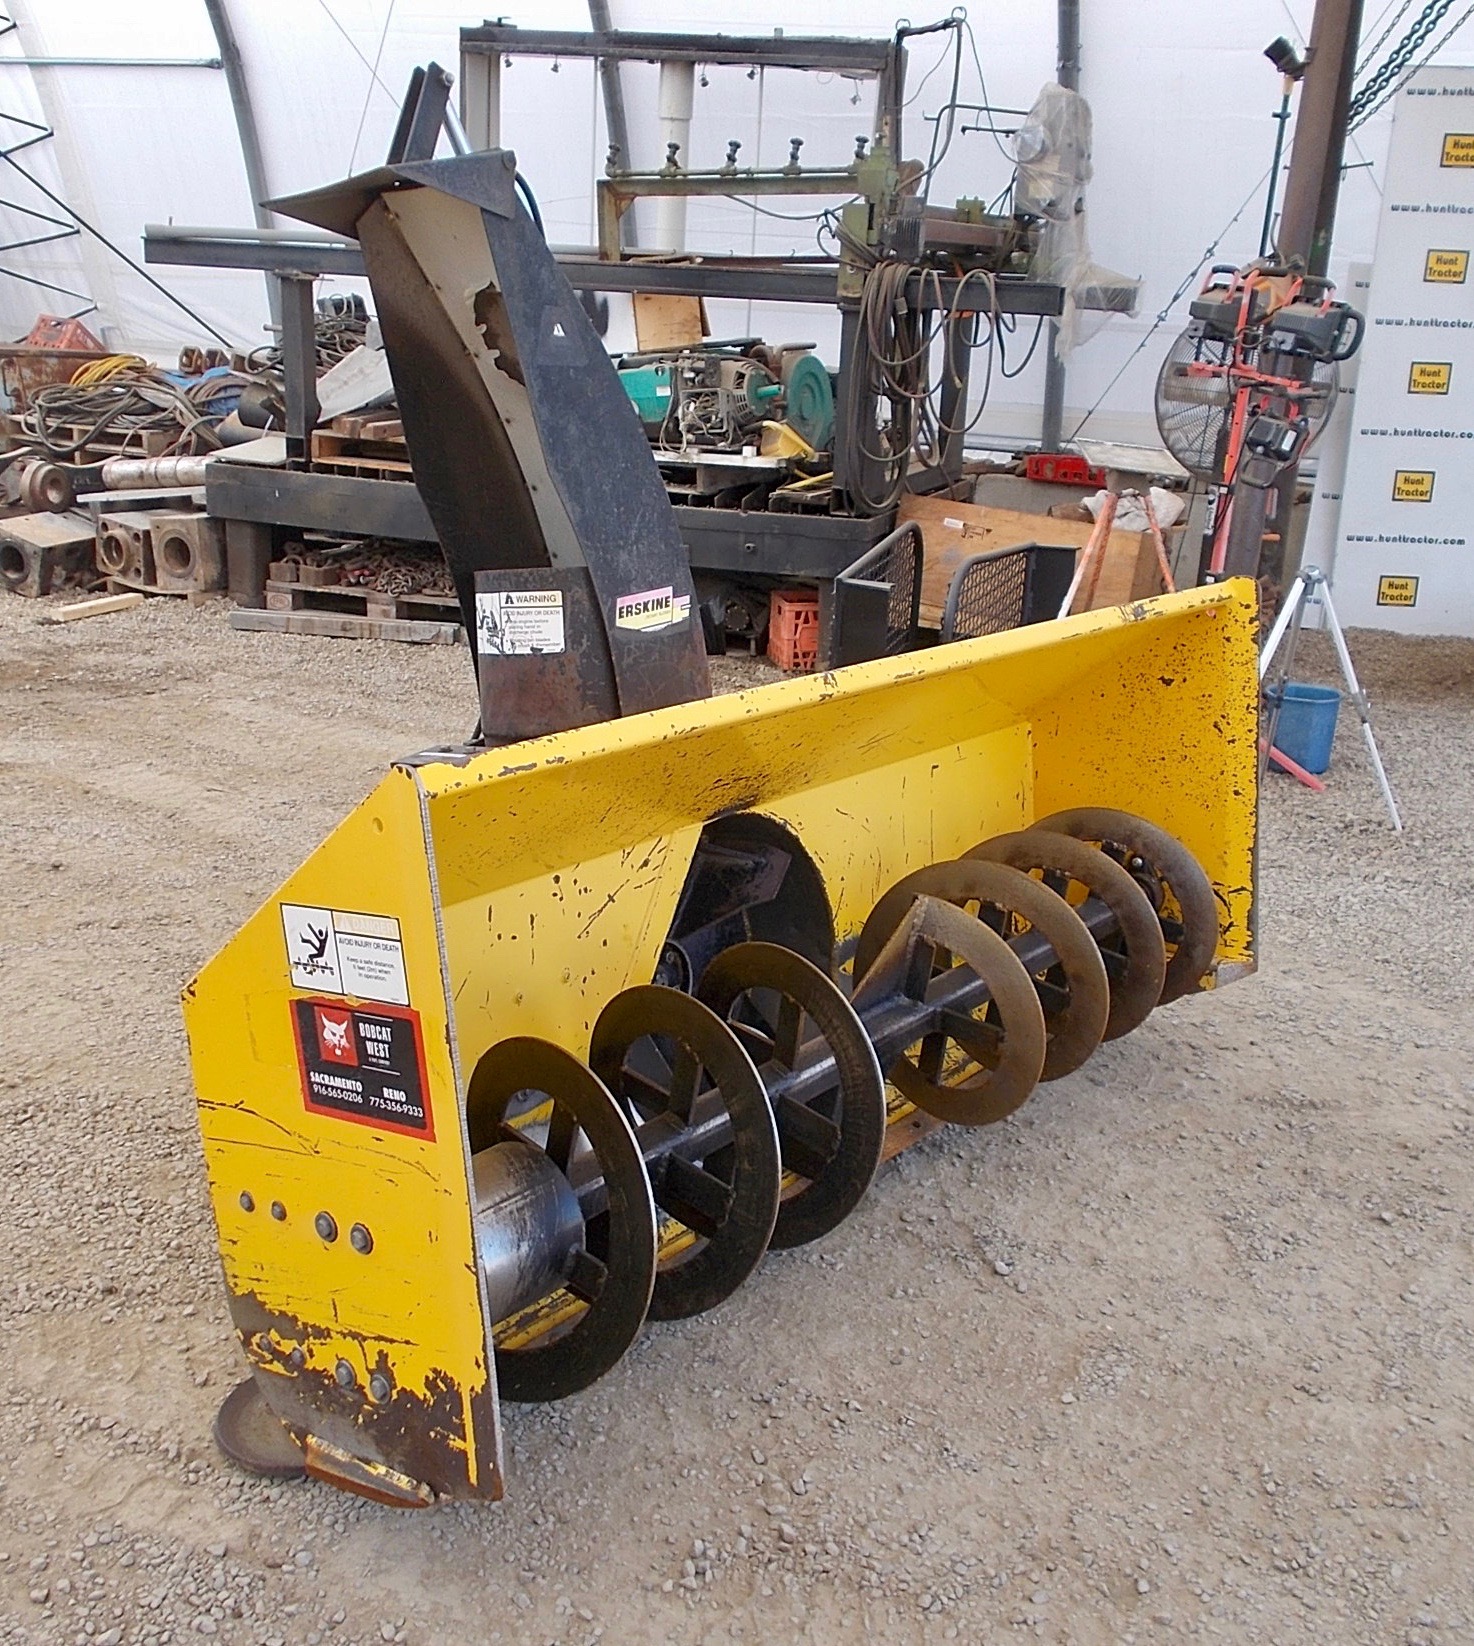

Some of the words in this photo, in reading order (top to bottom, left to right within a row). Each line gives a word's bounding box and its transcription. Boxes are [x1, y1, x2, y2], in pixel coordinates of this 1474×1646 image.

[1436, 255, 1459, 265] Hunt
[1428, 267, 1463, 278] Tractor
[1419, 367, 1441, 377] Hunt
[1412, 379, 1446, 389] Tractor
[1360, 427, 1474, 439] www.hunttractor.co
[1403, 476, 1424, 486] Hunt
[1396, 487, 1429, 497] Tractor
[1346, 533, 1466, 545] www.hunttractor.com
[1388, 581, 1408, 590] Hunt
[516, 594, 557, 603] WARNING
[1381, 592, 1413, 602] Tractor
[618, 595, 671, 619] ERSKINE
[352, 917, 395, 936] DANGER
[338, 937, 354, 946] AVOID
[354, 939, 372, 949] INJURY
[372, 942, 381, 950] OR
[381, 943, 399, 953] DEATH
[346, 956, 359, 964] Keep
[359, 1022, 392, 1042] BOBCAT
[365, 1040, 390, 1059] WEST
[309, 1070, 363, 1093] SACRAMENTO
[313, 1083, 364, 1104] 916-565-0206
[382, 1087, 407, 1103] RENO
[369, 1096, 424, 1118] 775-356-9333
